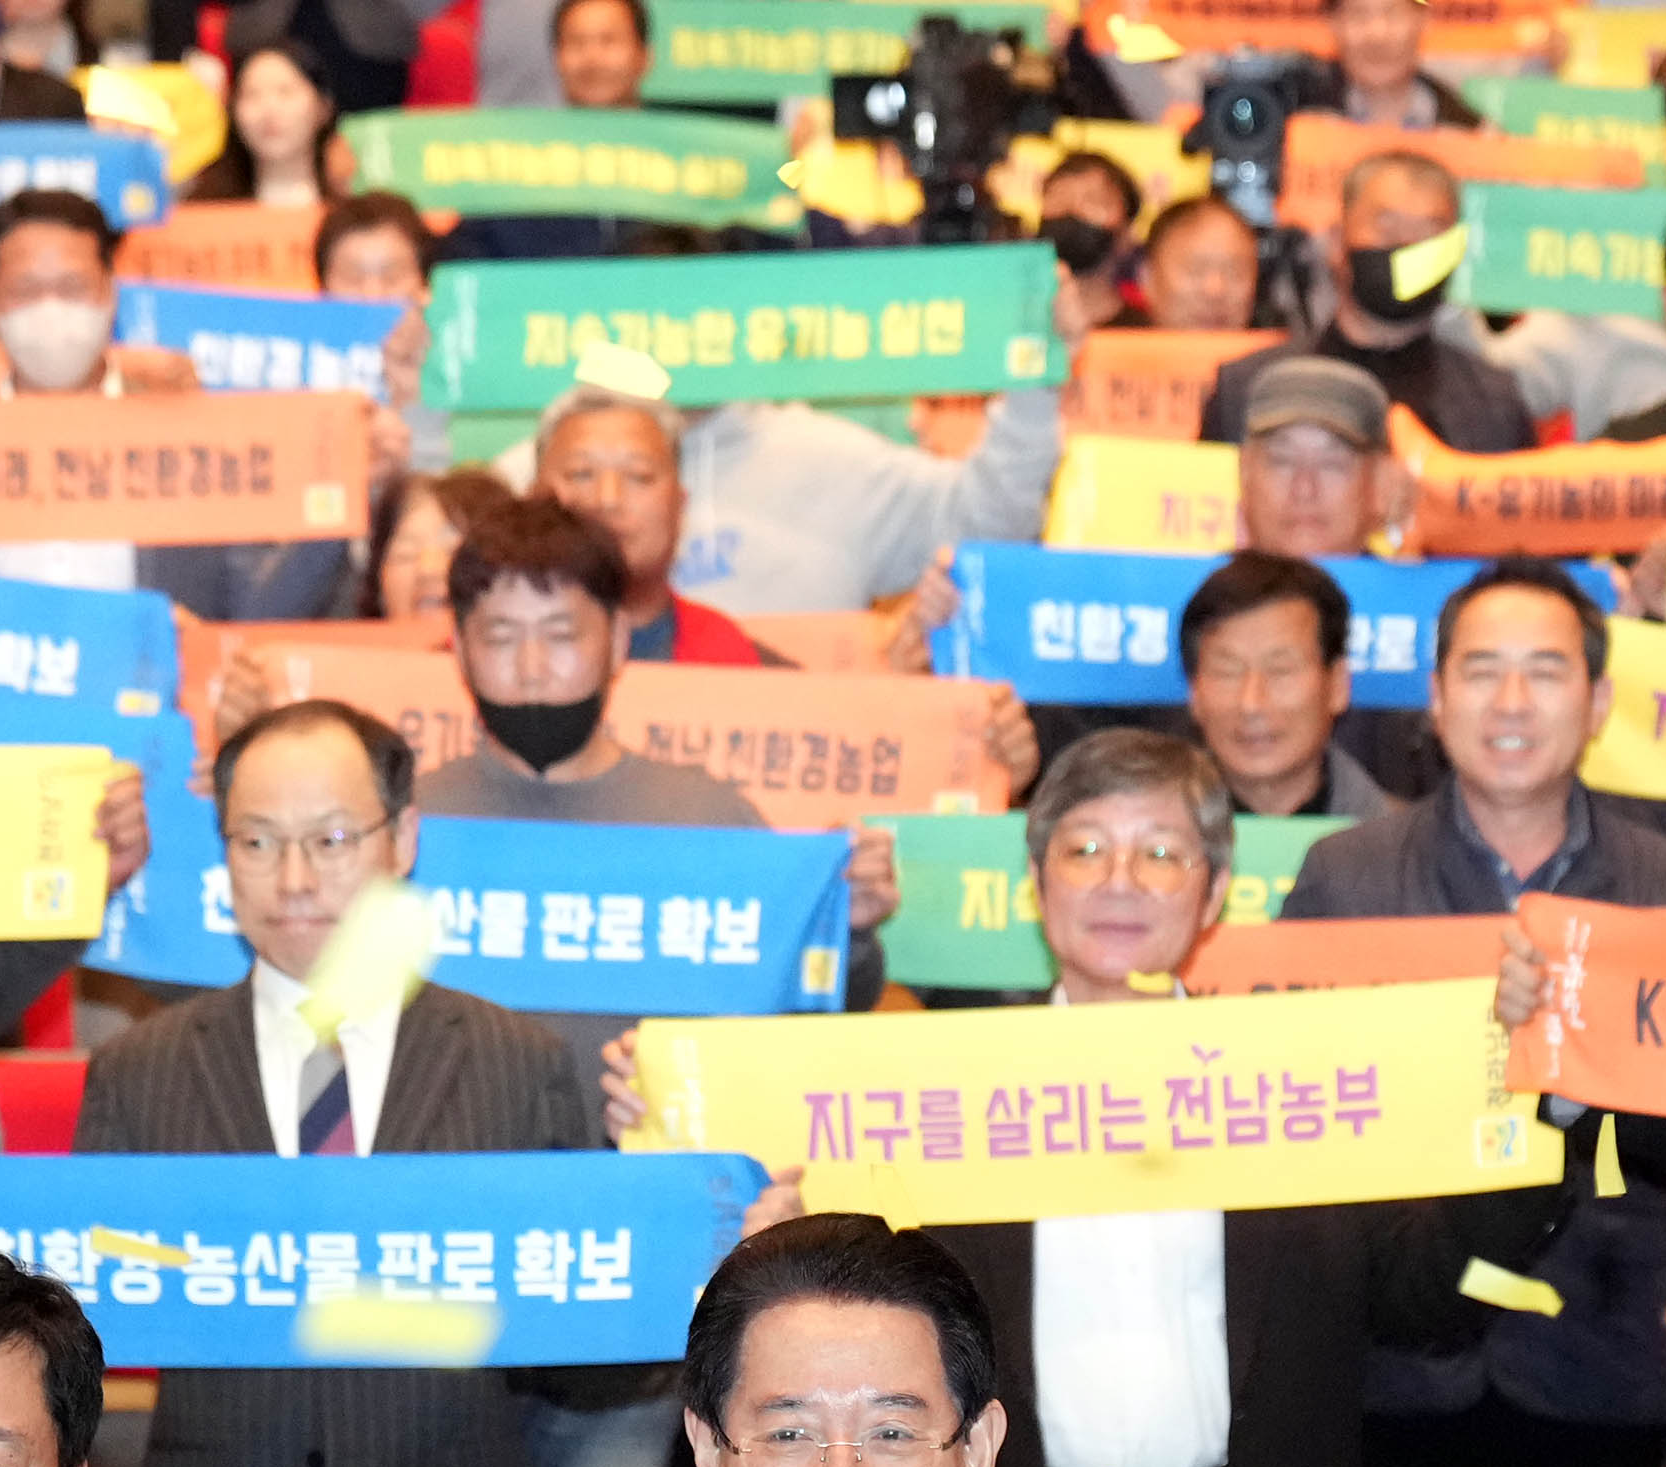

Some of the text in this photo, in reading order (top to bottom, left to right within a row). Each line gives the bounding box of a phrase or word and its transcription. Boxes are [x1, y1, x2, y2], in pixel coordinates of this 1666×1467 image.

[1030, 599, 1169, 665] 친환경
[541, 892, 645, 962] 판로
[657, 896, 762, 964] 확보
[803, 1064, 1383, 1163] 지구를 살리는 전남농부
[183, 1230, 362, 1308] 농산물
[375, 1230, 497, 1304] 판로
[515, 1228, 633, 1304] 확보
